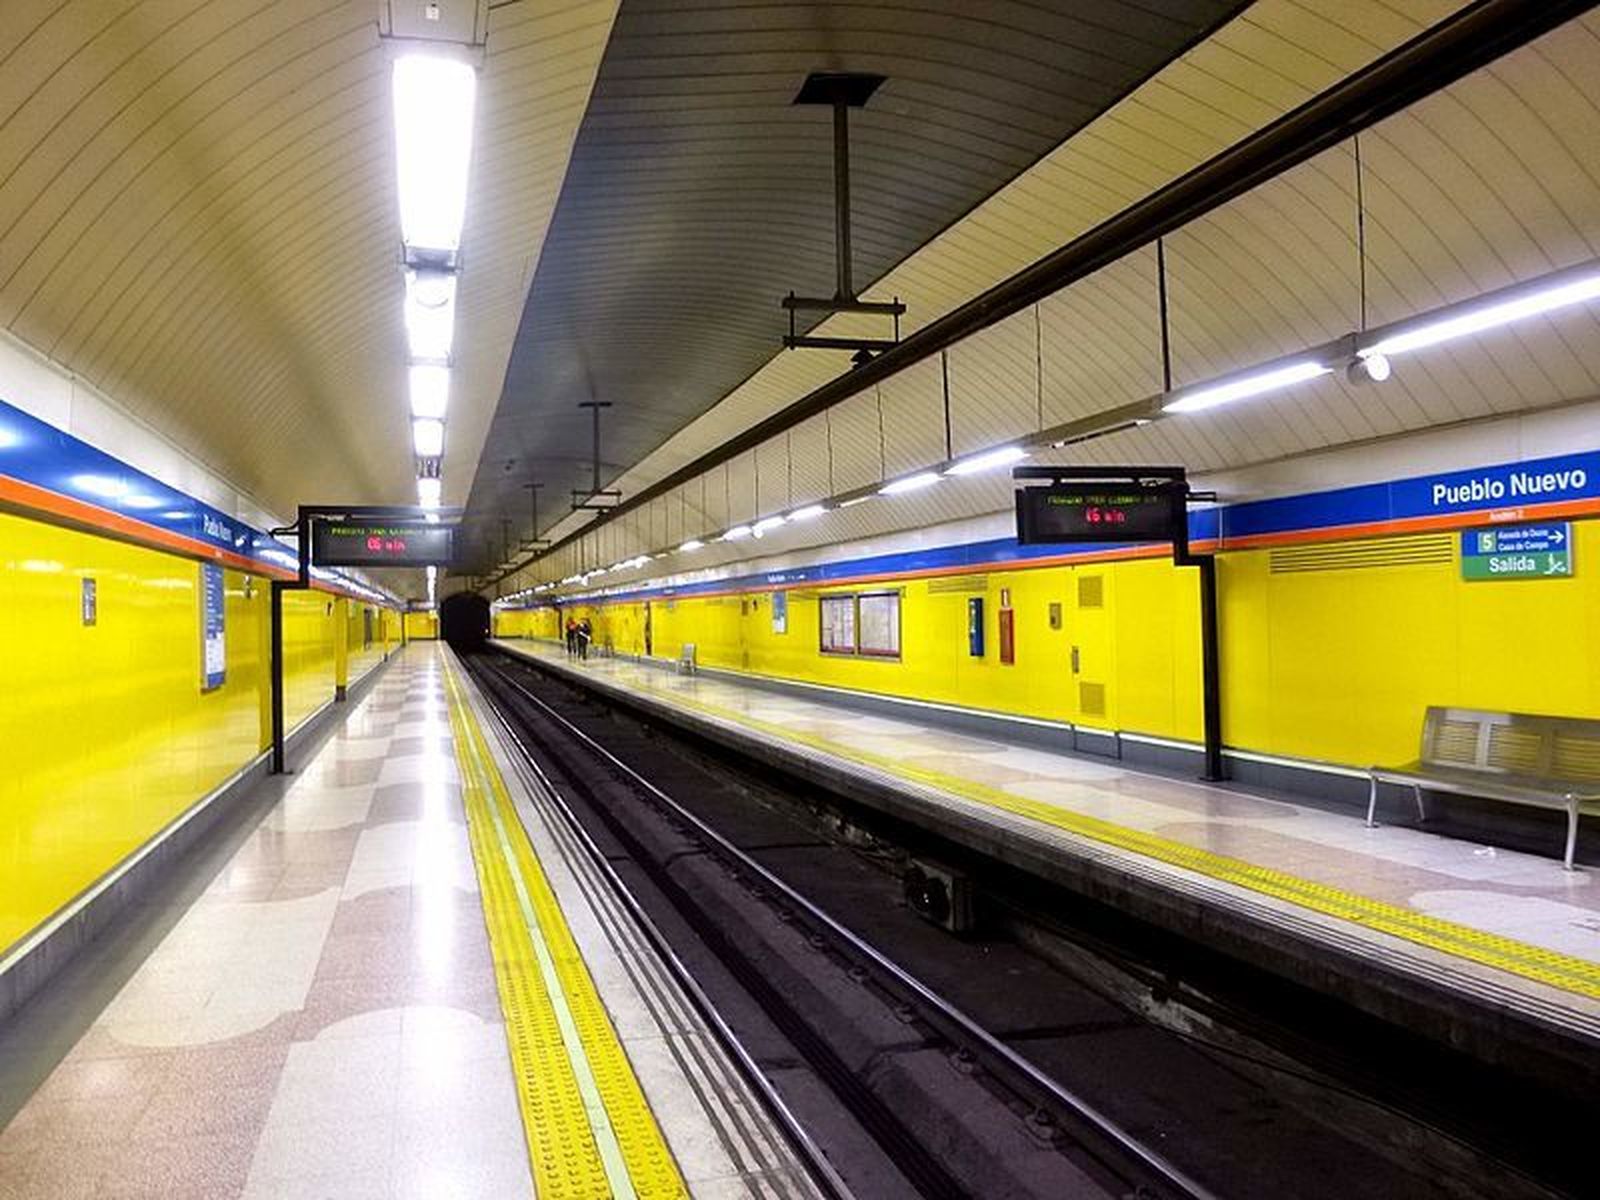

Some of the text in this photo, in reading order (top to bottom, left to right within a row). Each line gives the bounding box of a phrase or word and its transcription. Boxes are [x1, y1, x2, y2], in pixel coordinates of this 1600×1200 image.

[1433, 469, 1586, 505] Pueblo Nuevo
[1481, 533, 1493, 550] 5
[1489, 555, 1536, 573] Salida
